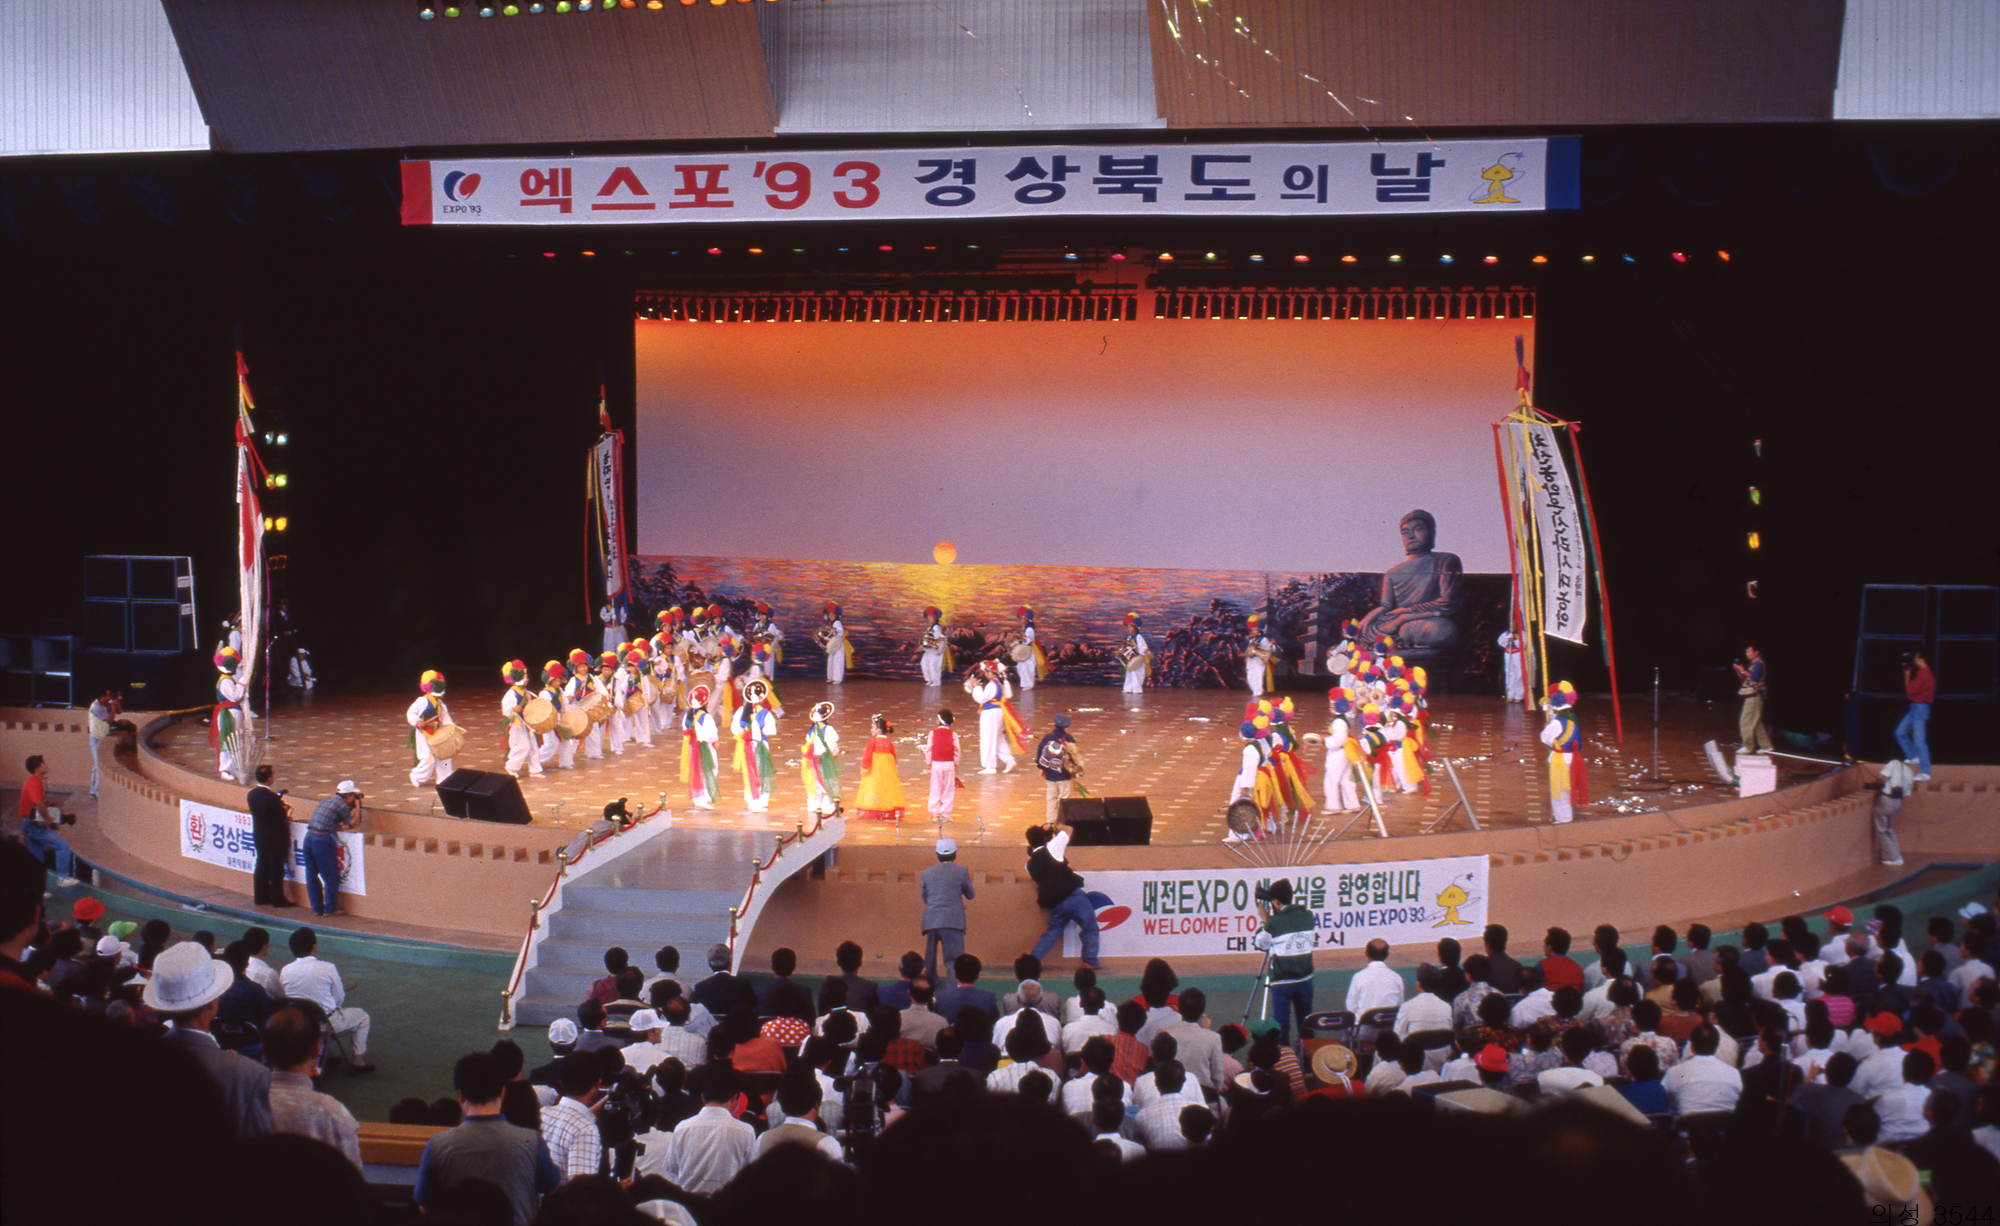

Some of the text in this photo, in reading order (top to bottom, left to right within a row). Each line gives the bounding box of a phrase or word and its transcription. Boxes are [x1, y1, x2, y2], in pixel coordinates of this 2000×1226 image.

[915, 155, 1328, 206] 경상북도의
[1371, 153, 1445, 202] 날
[1336, 869, 1420, 907] 환영합니다
[1144, 917, 1227, 934] WELCOME
[1235, 916, 1256, 931] TO
[1313, 911, 1365, 930] AEJON
